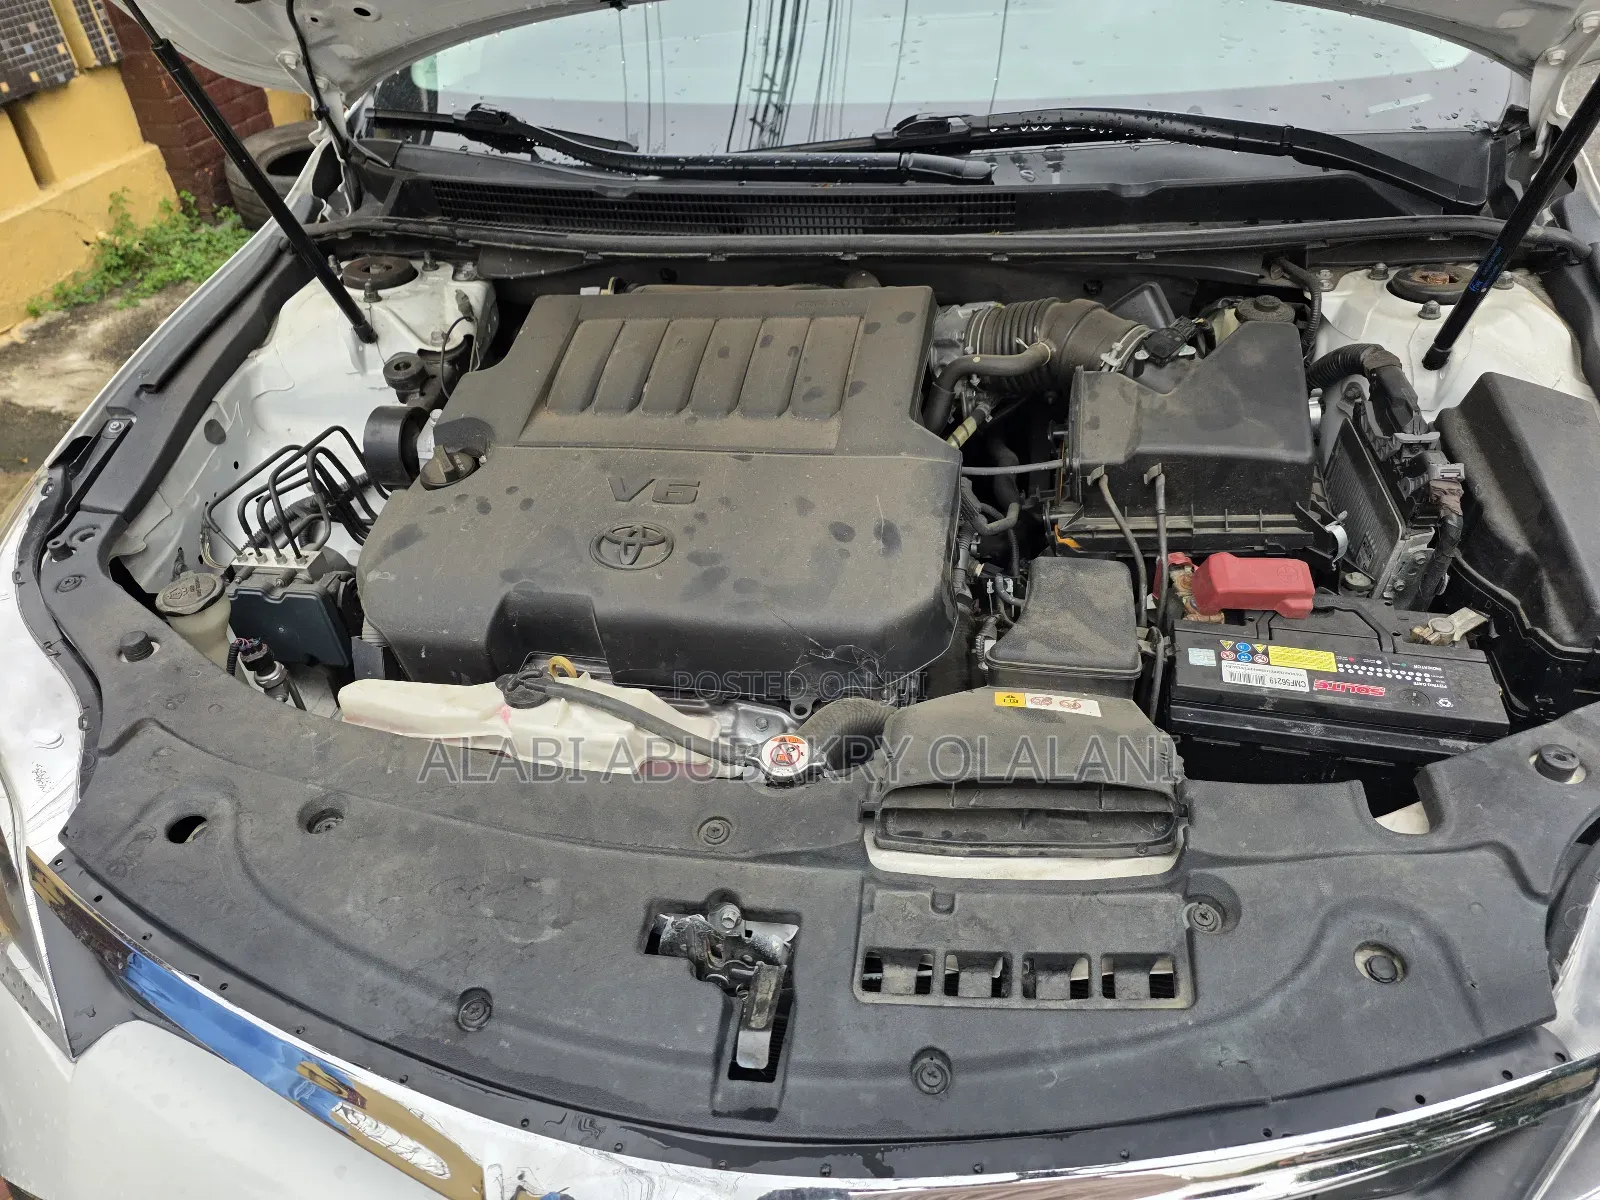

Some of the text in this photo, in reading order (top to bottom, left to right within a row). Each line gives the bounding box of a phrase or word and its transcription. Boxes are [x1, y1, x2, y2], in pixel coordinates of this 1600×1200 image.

[607, 476, 701, 505] V6
[1269, 676, 1307, 688] CMF56219
[1313, 678, 1386, 697] SOLITE
